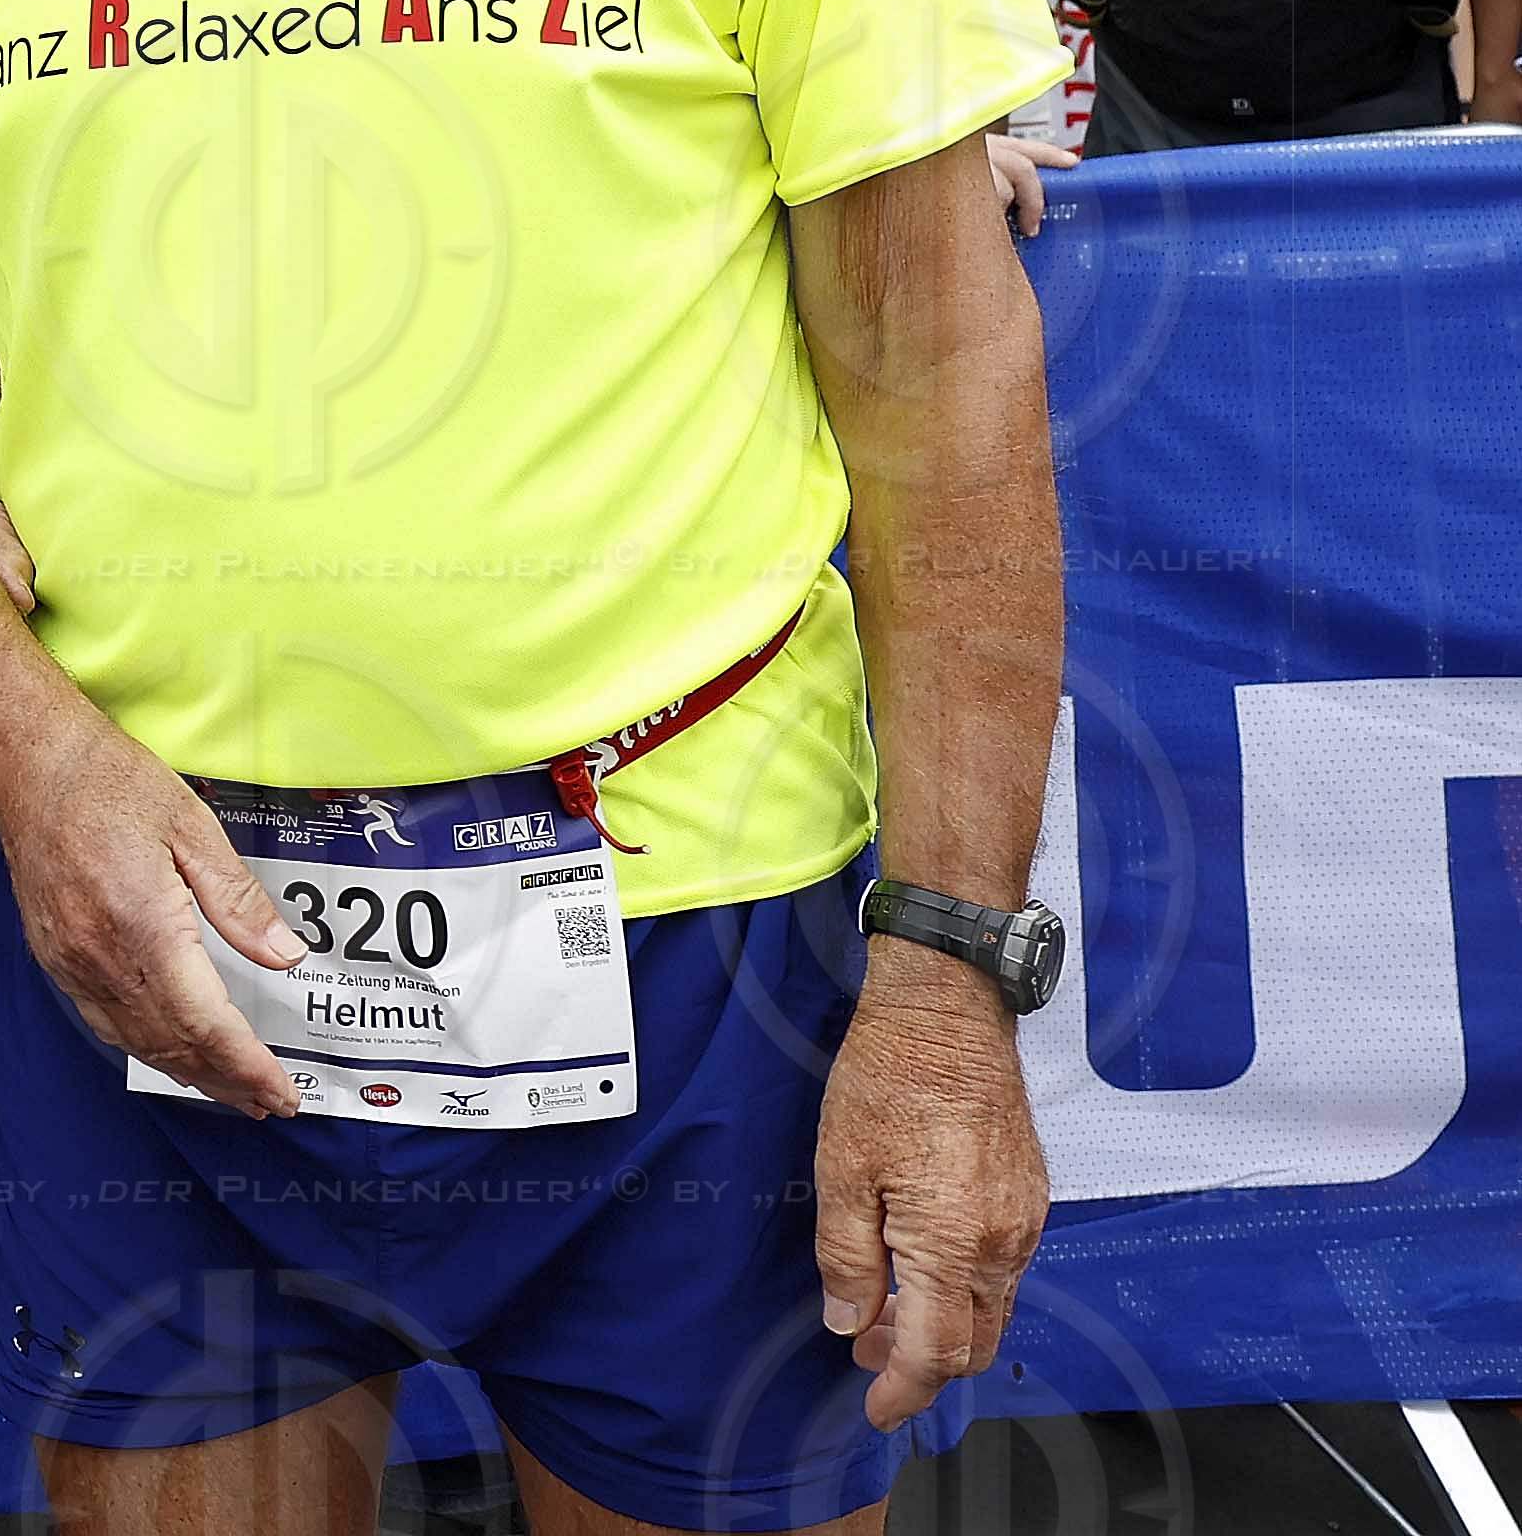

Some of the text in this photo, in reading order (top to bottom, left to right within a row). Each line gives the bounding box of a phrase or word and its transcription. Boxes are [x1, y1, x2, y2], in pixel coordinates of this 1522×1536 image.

[219, 810, 299, 828] MARATHON
[278, 830, 311, 844] 2023
[456, 813, 553, 849] GRAZ
[516, 837, 557, 852] HOLDING
[281, 880, 449, 970] 320
[287, 967, 461, 997] Kleine Zeitung Marathon
[307, 990, 446, 1031] Helmut
[363, 1088, 398, 1102] Hervis
[543, 1083, 583, 1096] Das Land
